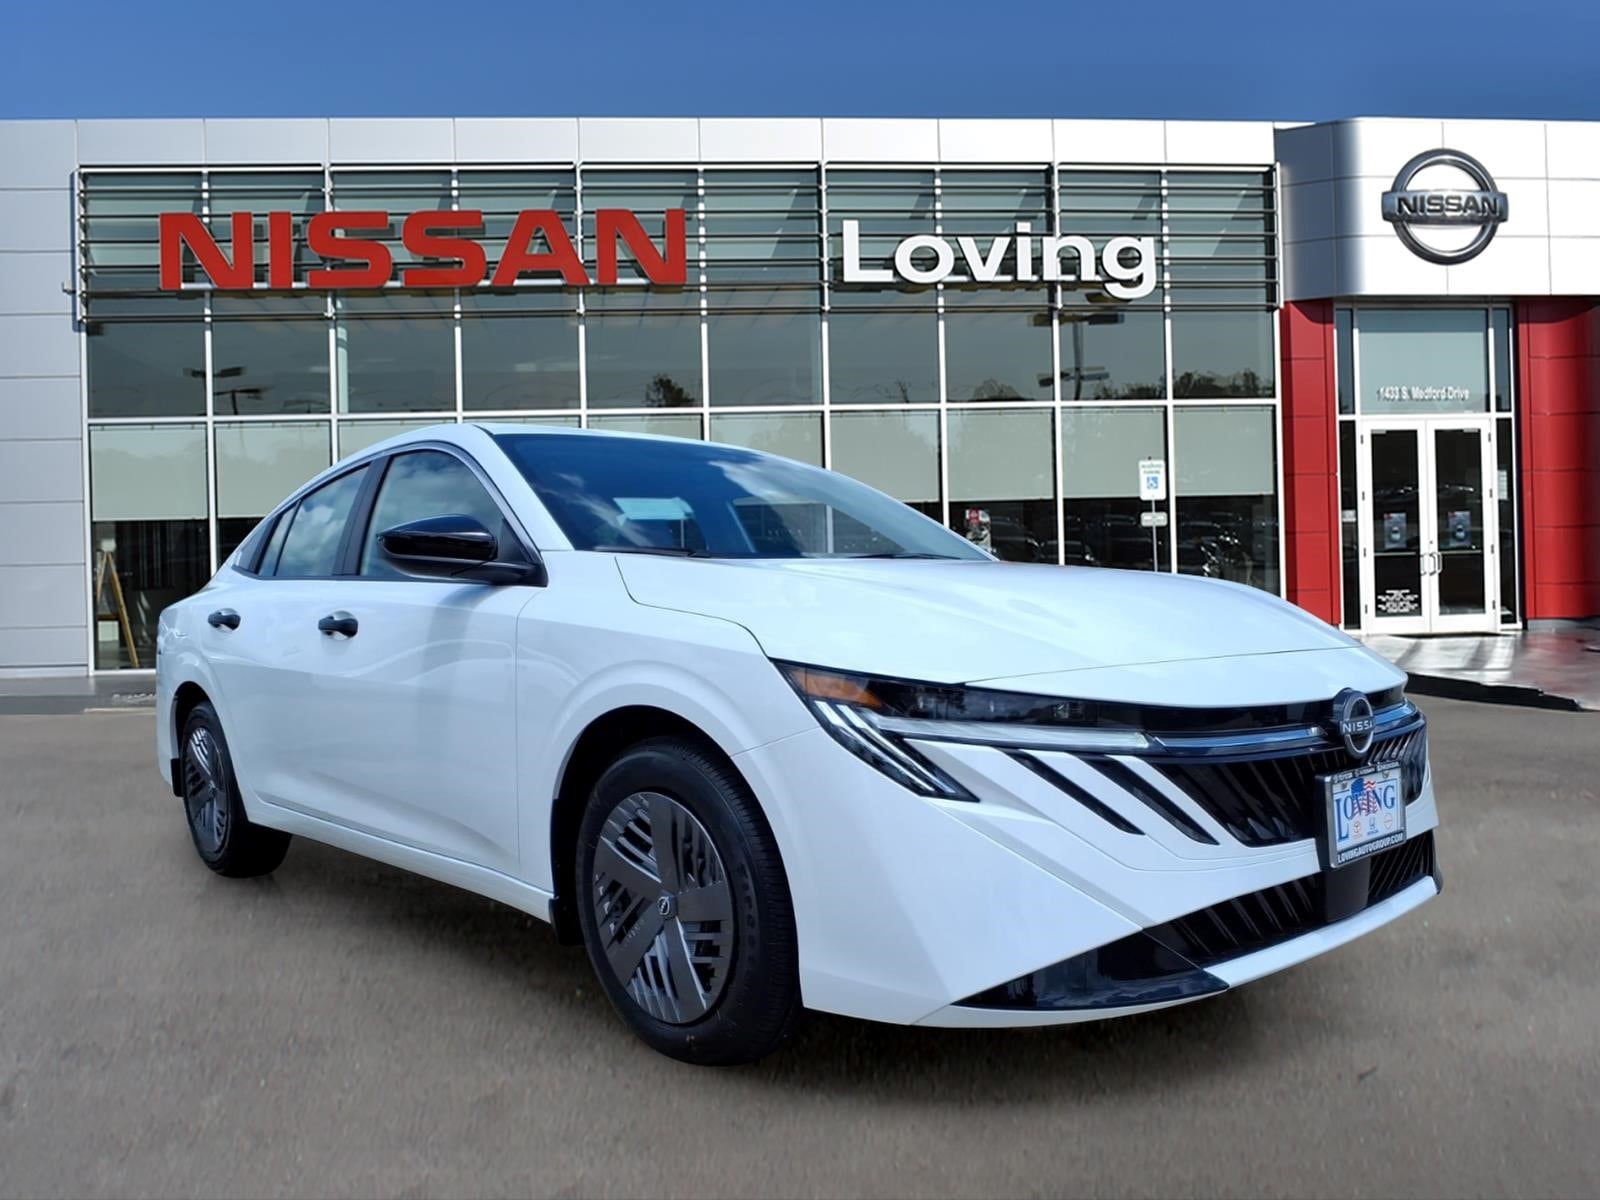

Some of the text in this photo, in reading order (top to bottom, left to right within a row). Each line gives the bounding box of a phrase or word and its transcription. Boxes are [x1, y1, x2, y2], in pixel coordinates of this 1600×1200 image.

[1396, 194, 1499, 215] NISSAN
[159, 208, 687, 290] NISSAN
[842, 219, 1156, 299] Loving
[1447, 386, 1470, 400] Drive
[1335, 784, 1396, 842] LOVING
